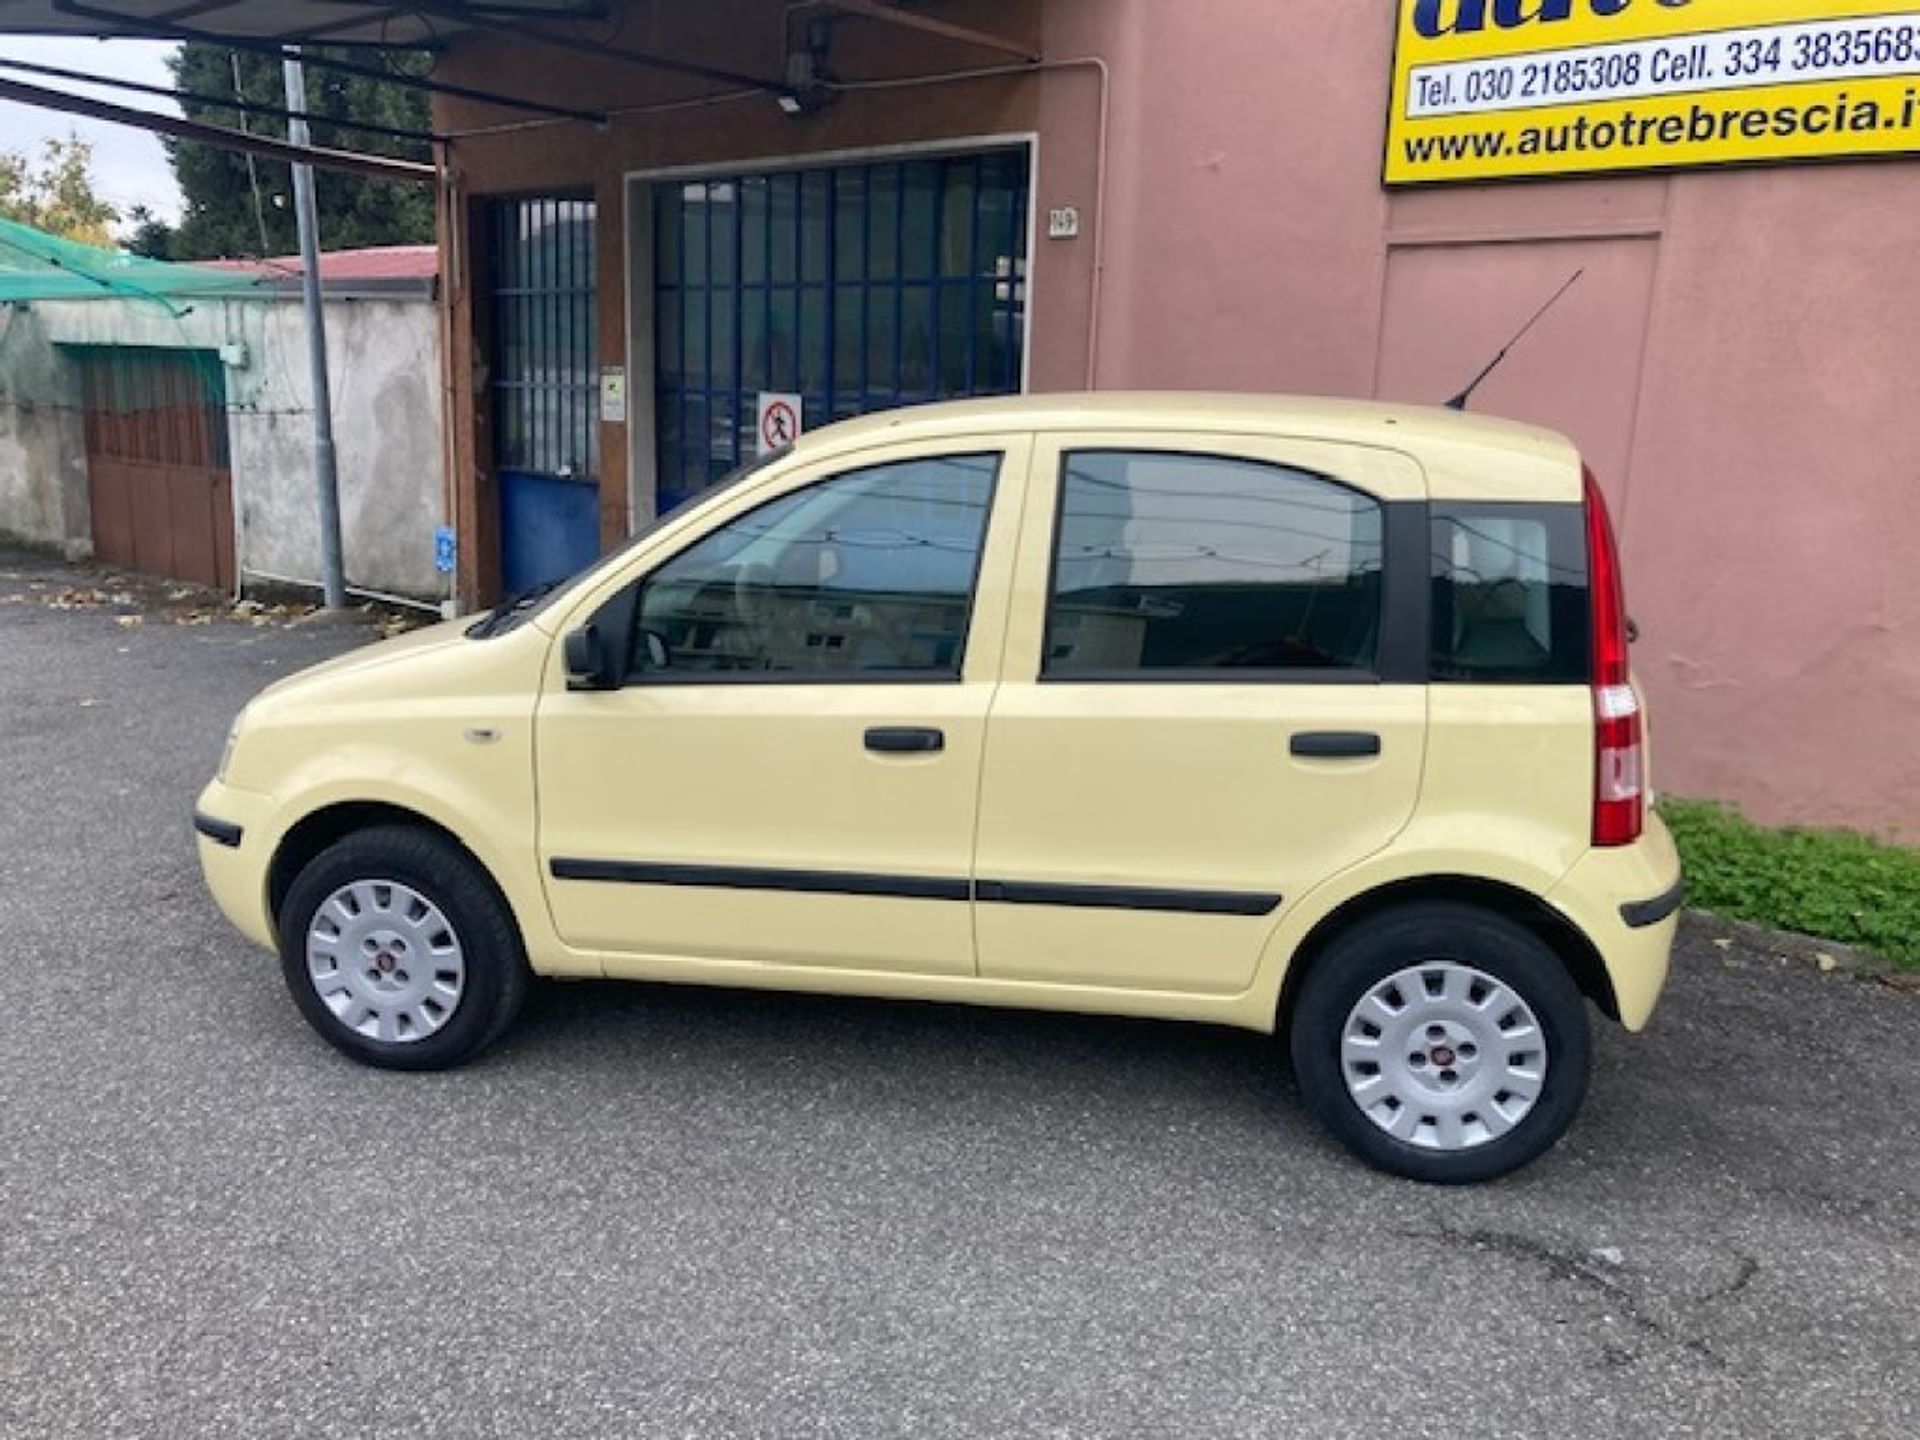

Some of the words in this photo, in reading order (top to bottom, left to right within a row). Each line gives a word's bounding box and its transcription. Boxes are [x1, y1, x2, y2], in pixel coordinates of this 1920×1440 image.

[1417, 74, 1457, 106] Tel.
[1466, 66, 1513, 103] 030
[1520, 52, 1641, 97] 2185308
[1650, 44, 1712, 83] Cell.
[1724, 36, 1781, 77] 334
[1404, 88, 1920, 163] www.autotrebrescia.i
